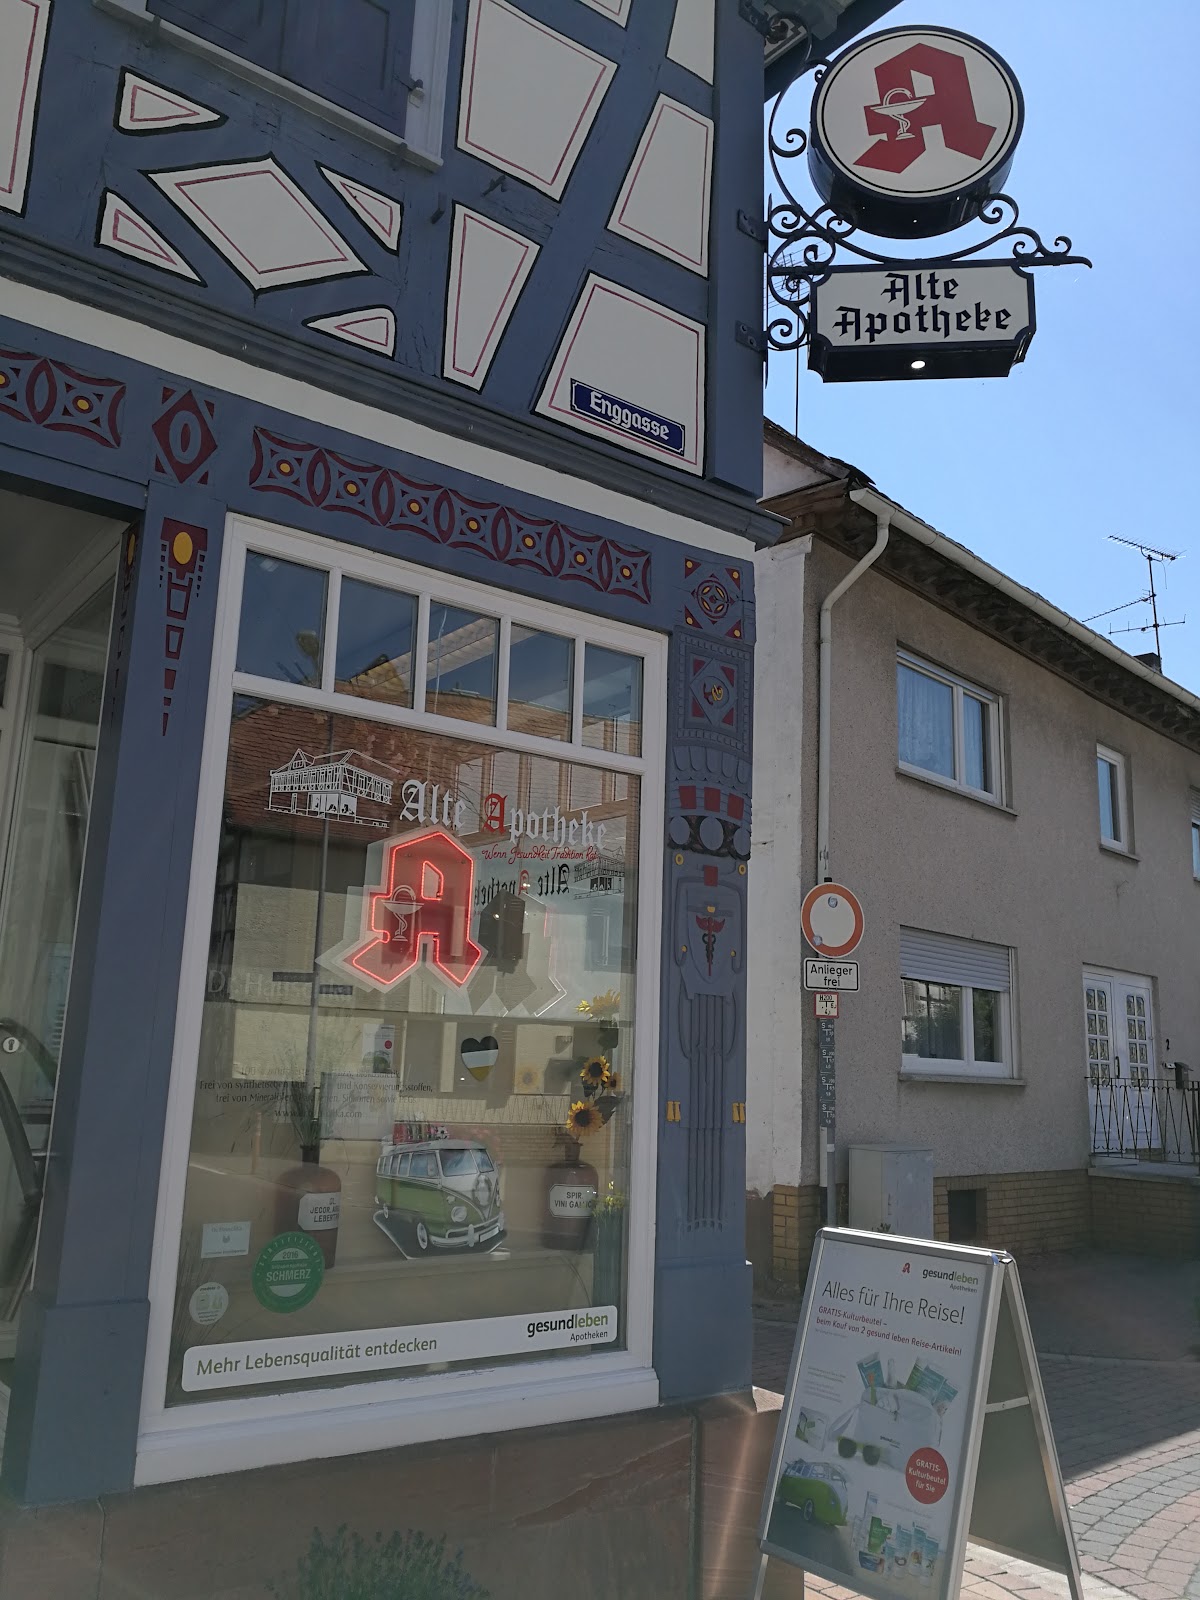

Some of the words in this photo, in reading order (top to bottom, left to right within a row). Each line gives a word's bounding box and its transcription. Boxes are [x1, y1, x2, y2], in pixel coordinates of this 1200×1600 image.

[880, 271, 959, 308] Alte
[832, 302, 1012, 343] Apotheke
[589, 391, 670, 440] Enggasse
[400, 779, 467, 832] Alte
[481, 793, 608, 849] Apotheke
[481, 844, 507, 860] Wenn
[810, 963, 853, 977] Anlieger
[823, 975, 841, 987] frei
[1165, 1038, 1171, 1052] 2
[217, 1082, 233, 1090] von
[337, 1081, 352, 1090] und
[231, 1094, 247, 1102] von
[566, 1191, 583, 1200] SPIR.
[554, 1200, 568, 1208] VINI
[266, 1268, 312, 1282] SCHMERZ
[922, 1267, 979, 1285] gesundleben
[949, 1282, 978, 1293] Apotheken
[822, 1280, 855, 1303] Alles
[858, 1286, 880, 1307] für
[882, 1291, 914, 1315] Ihre
[917, 1298, 966, 1325] Reise!
[818, 1305, 882, 1326] GRATIS-Kulturbeutel
[527, 1313, 608, 1338] gesundleben
[569, 1330, 608, 1342] Apotheken
[816, 1316, 832, 1327] beim
[832, 1319, 848, 1330] Kauf
[848, 1325, 860, 1333] von
[860, 1326, 866, 1335] 2
[866, 1329, 890, 1341] gesund
[891, 1331, 910, 1345] leben
[911, 1337, 962, 1356] Reise-Artikeln!
[196, 1358, 241, 1376] Mehr
[245, 1345, 361, 1370] Lebensqualität
[366, 1338, 437, 1357] entdecken
[915, 1458, 940, 1472] GRATIS-
[908, 1466, 946, 1485] Kulturbeutel
[915, 1480, 924, 1489] für
[925, 1483, 936, 1493] Sie
